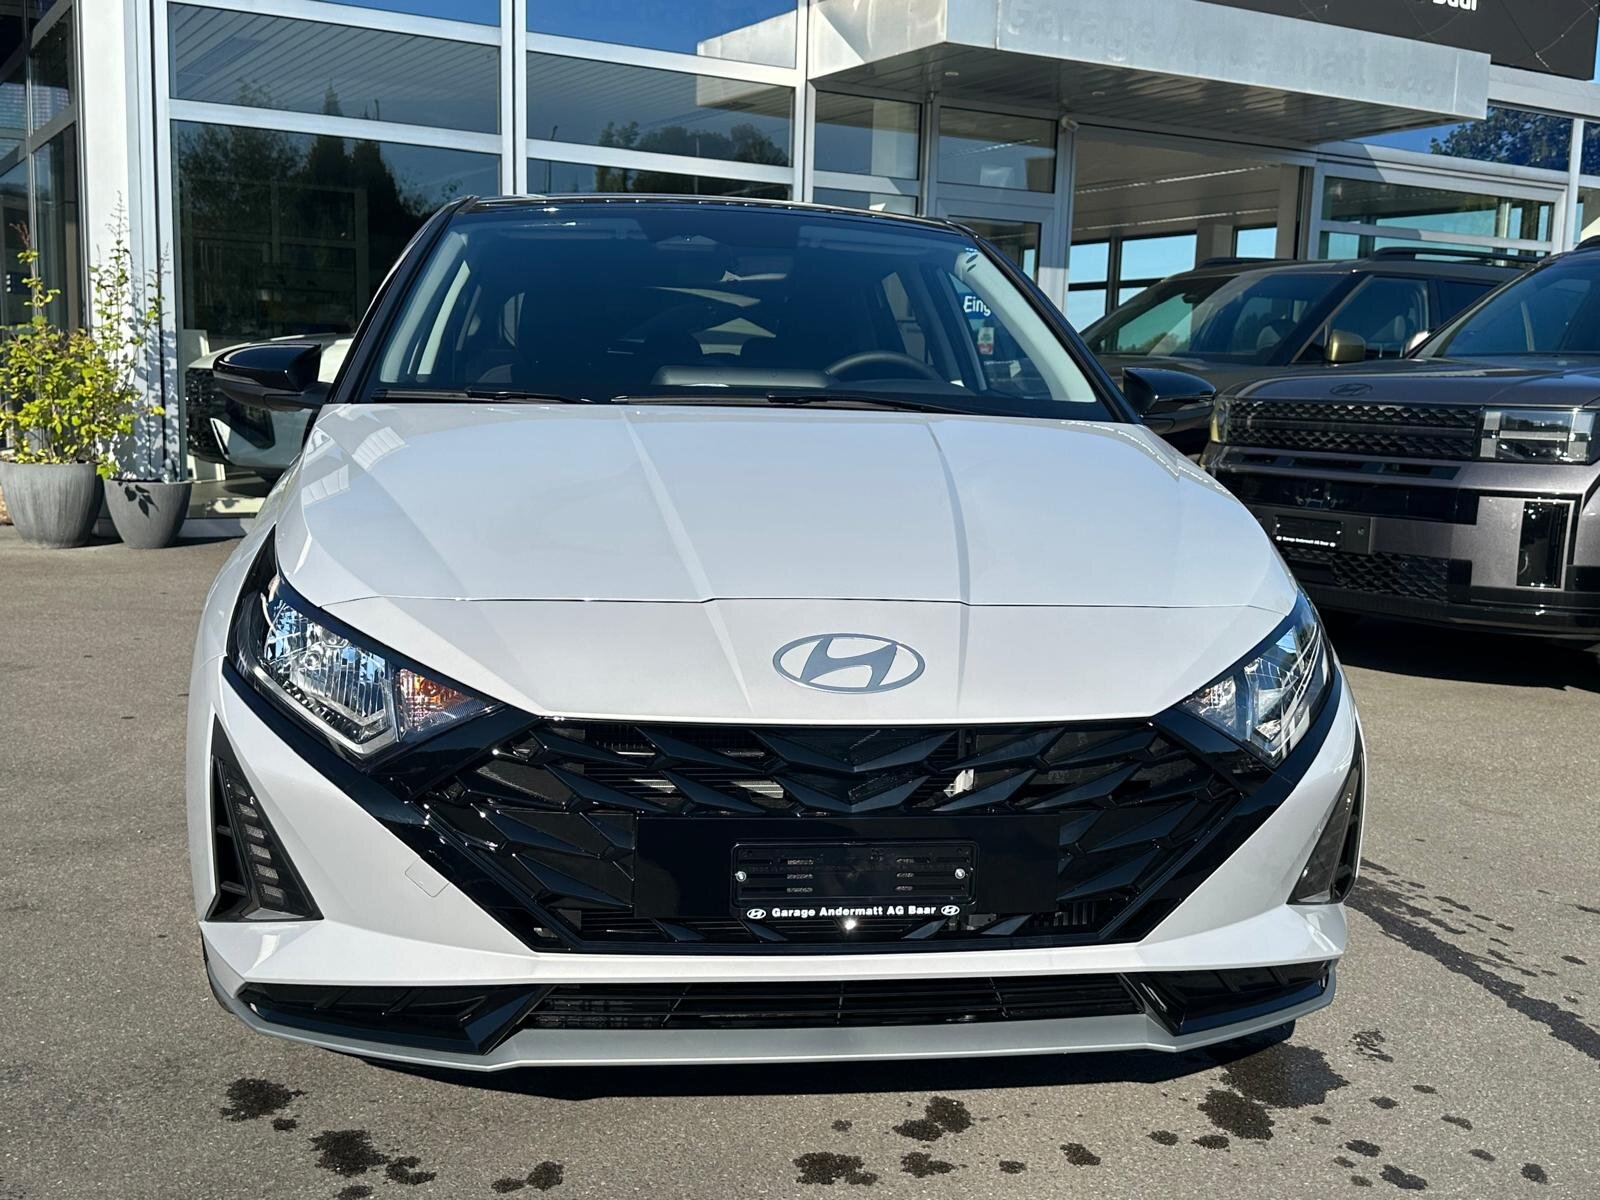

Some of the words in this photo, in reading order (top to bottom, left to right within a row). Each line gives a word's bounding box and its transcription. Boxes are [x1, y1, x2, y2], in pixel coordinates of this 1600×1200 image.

[771, 907, 816, 919] Garage
[819, 906, 883, 917] Andermatt
[886, 905, 905, 915] AG
[908, 905, 937, 915] Baar
